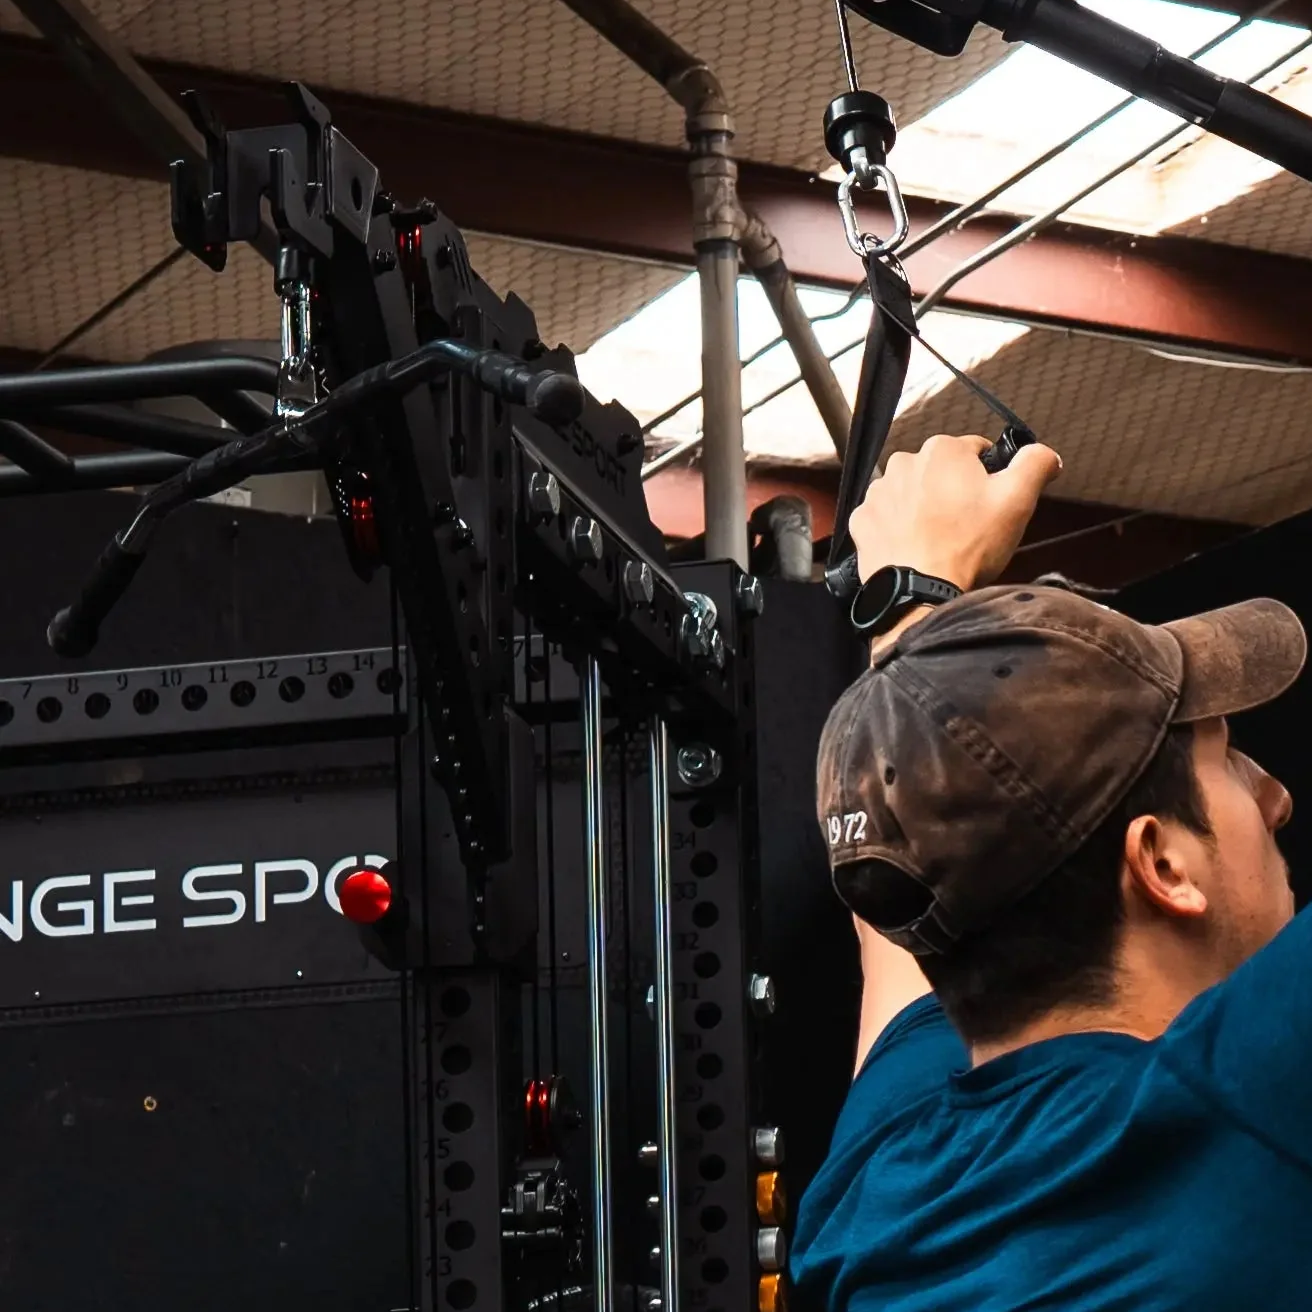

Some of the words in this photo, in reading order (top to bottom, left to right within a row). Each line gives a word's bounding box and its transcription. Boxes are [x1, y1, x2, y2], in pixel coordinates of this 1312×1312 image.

[159, 669, 182, 687] 10
[208, 665, 229, 684] 11
[257, 661, 278, 679] 12
[306, 657, 328, 676] 13
[353, 653, 375, 671] 14
[827, 811, 868, 845] 1972
